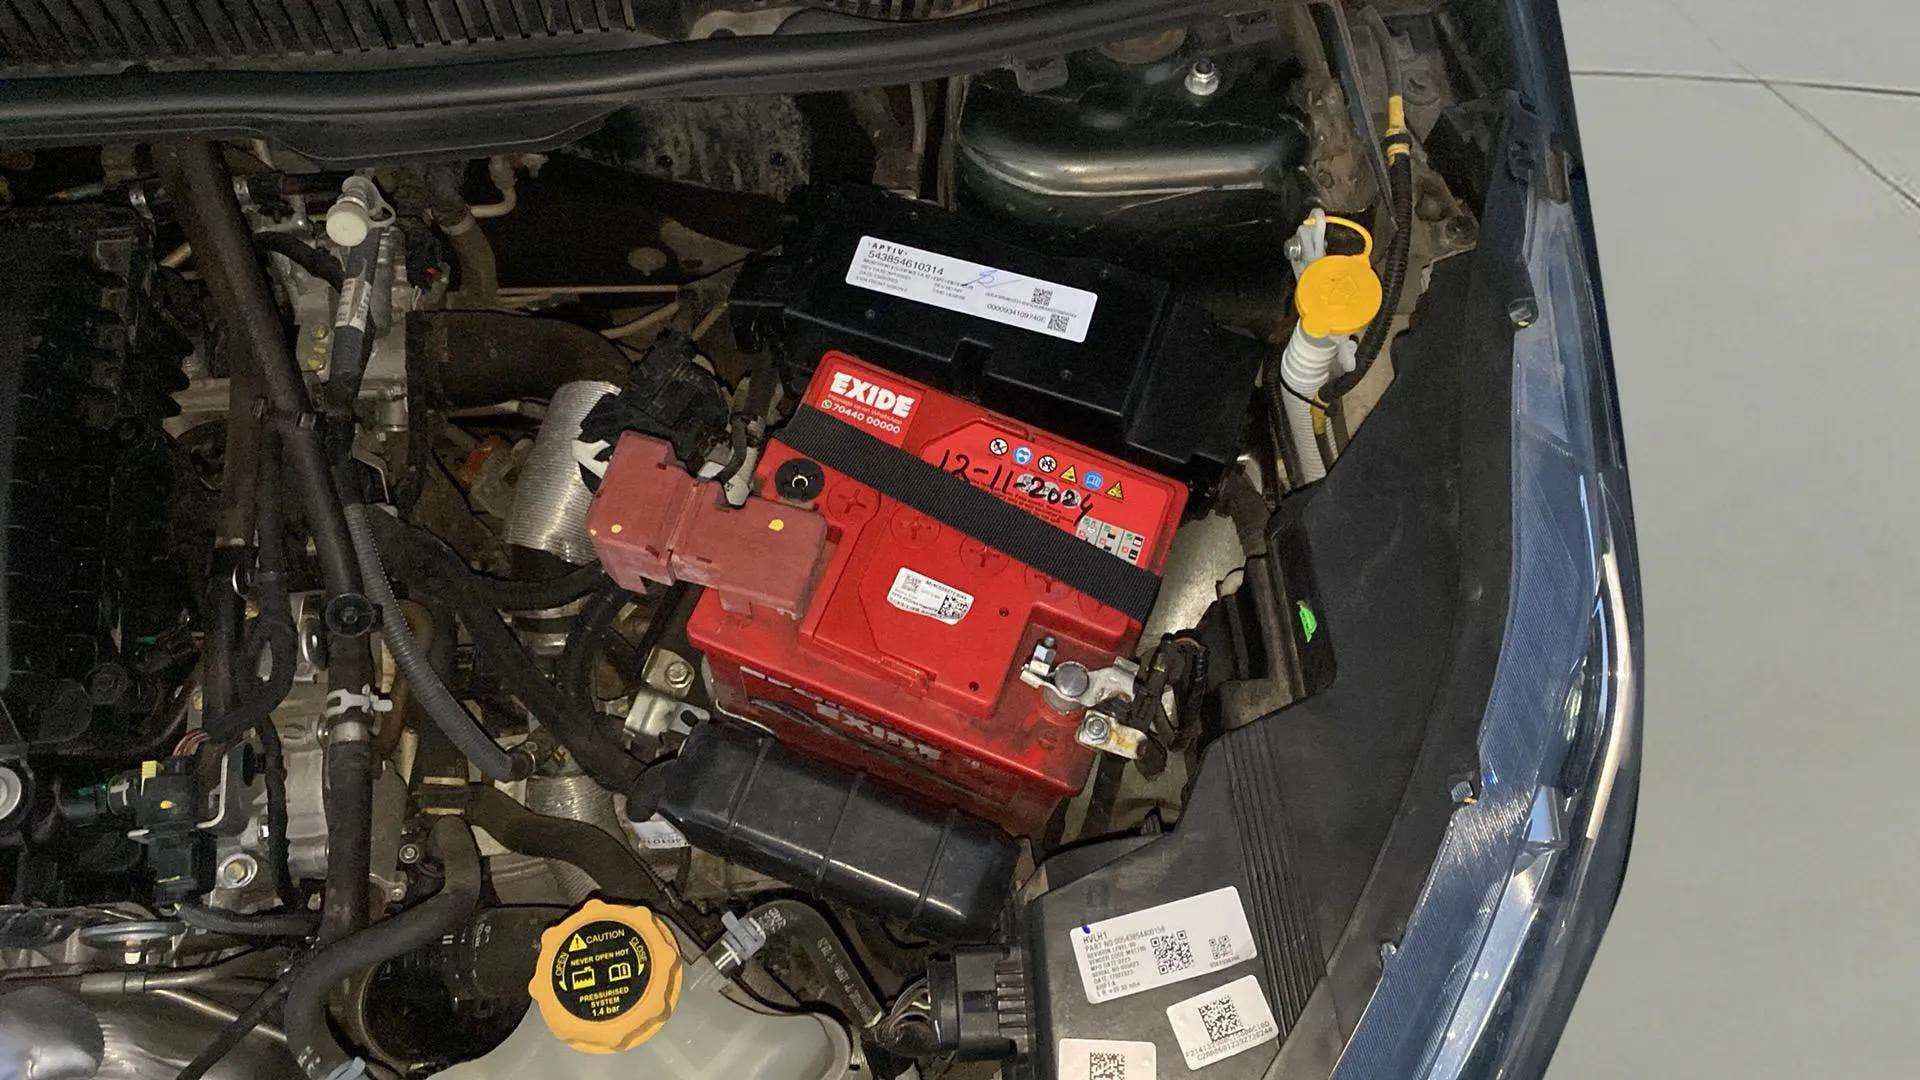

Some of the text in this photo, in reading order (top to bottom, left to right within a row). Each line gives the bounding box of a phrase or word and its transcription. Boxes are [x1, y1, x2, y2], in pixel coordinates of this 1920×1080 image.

[867, 250, 945, 275] 543854610314
[830, 371, 916, 418] EXIDE
[832, 403, 901, 434] 70440 00000
[585, 929, 625, 945] CAUTION
[570, 948, 630, 967] NEVER OPEN HOT
[630, 936, 648, 962] CLOSE
[555, 951, 568, 977] OPEN
[579, 985, 630, 1003] PRESSURISED
[590, 996, 621, 1009] SYSTEM
[591, 1004, 621, 1018] 1.4 bar
